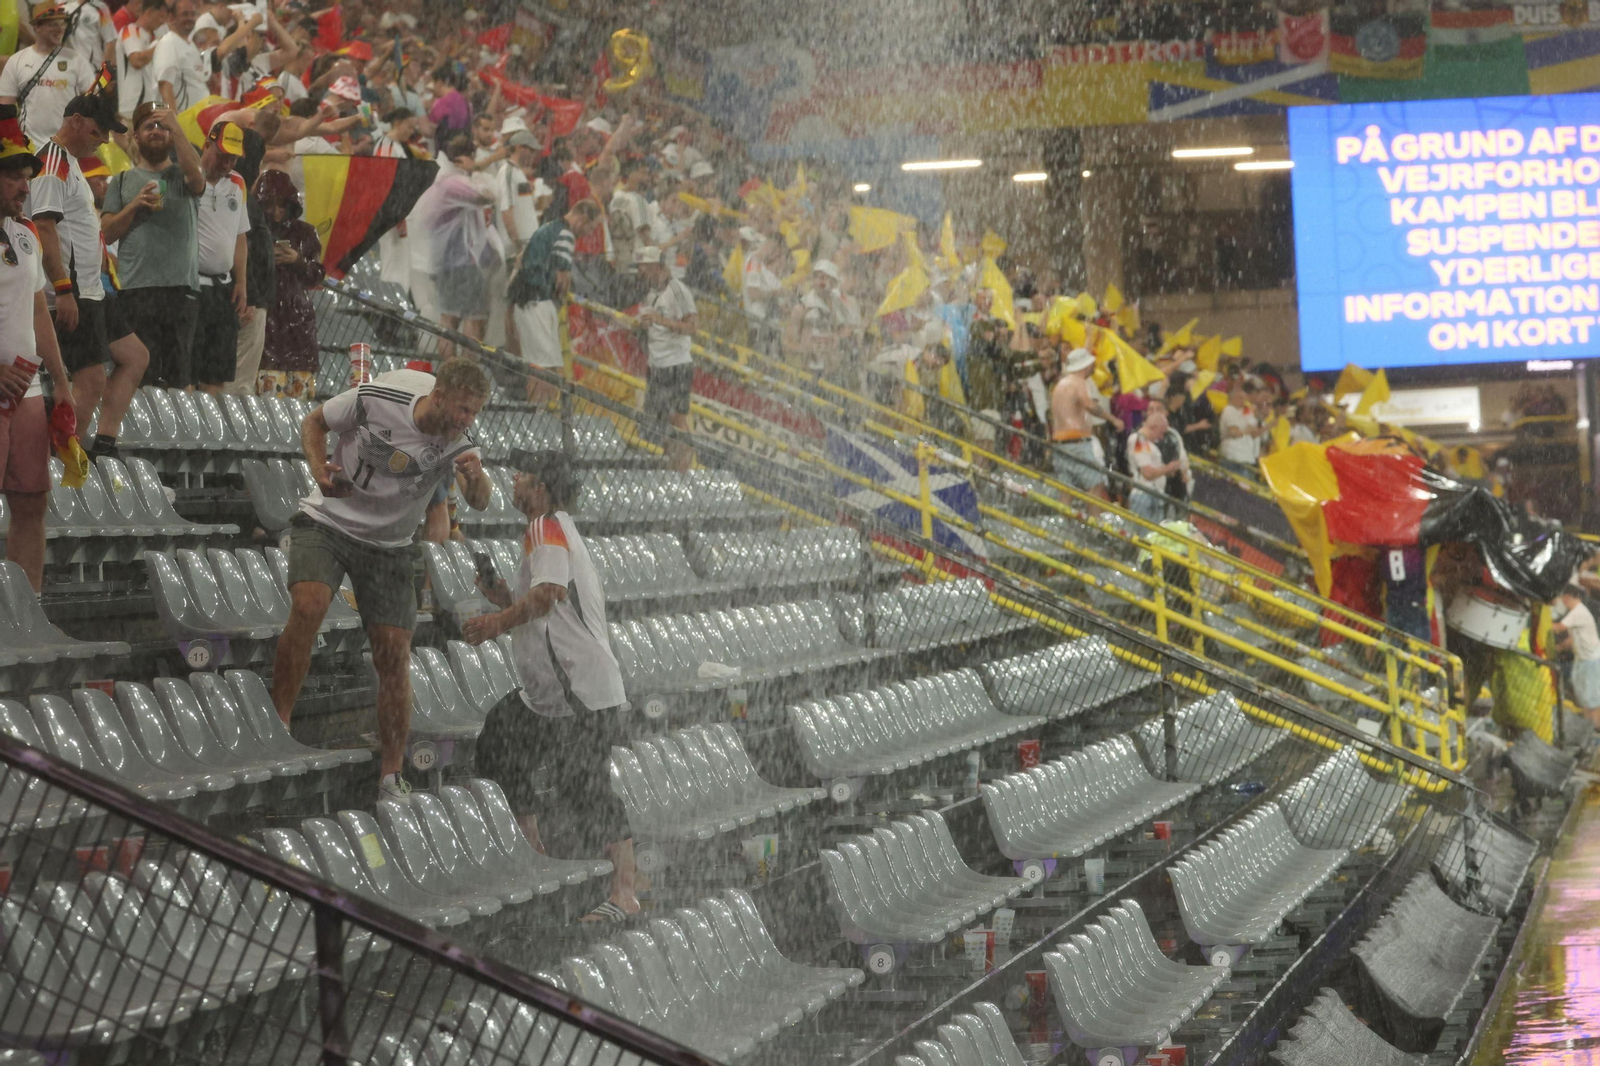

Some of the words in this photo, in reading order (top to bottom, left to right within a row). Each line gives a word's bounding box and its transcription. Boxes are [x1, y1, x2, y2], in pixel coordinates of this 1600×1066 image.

[603, 28, 649, 91] 9
[1337, 125, 1389, 164] PÅ
[1391, 129, 1524, 162] GRUND
[1529, 126, 1577, 155] AF
[1580, 125, 1600, 153] D
[1378, 157, 1600, 193] VEJRFORHO
[1390, 190, 1547, 225] KAMPEN
[1406, 220, 1600, 256] SUSPENDE
[1344, 284, 1599, 323] INFORMATION
[1428, 320, 1489, 350] OM
[1492, 316, 1595, 348] KORT
[1389, 550, 1406, 581] 8
[193, 652, 204, 662] 11
[650, 704, 661, 713] 10
[418, 754, 430, 764] 10
[838, 787, 845, 796] 9
[644, 856, 651, 865] 9
[1030, 870, 1036, 879] 8
[878, 957, 885, 967] 8
[1218, 955, 1224, 964] 7
